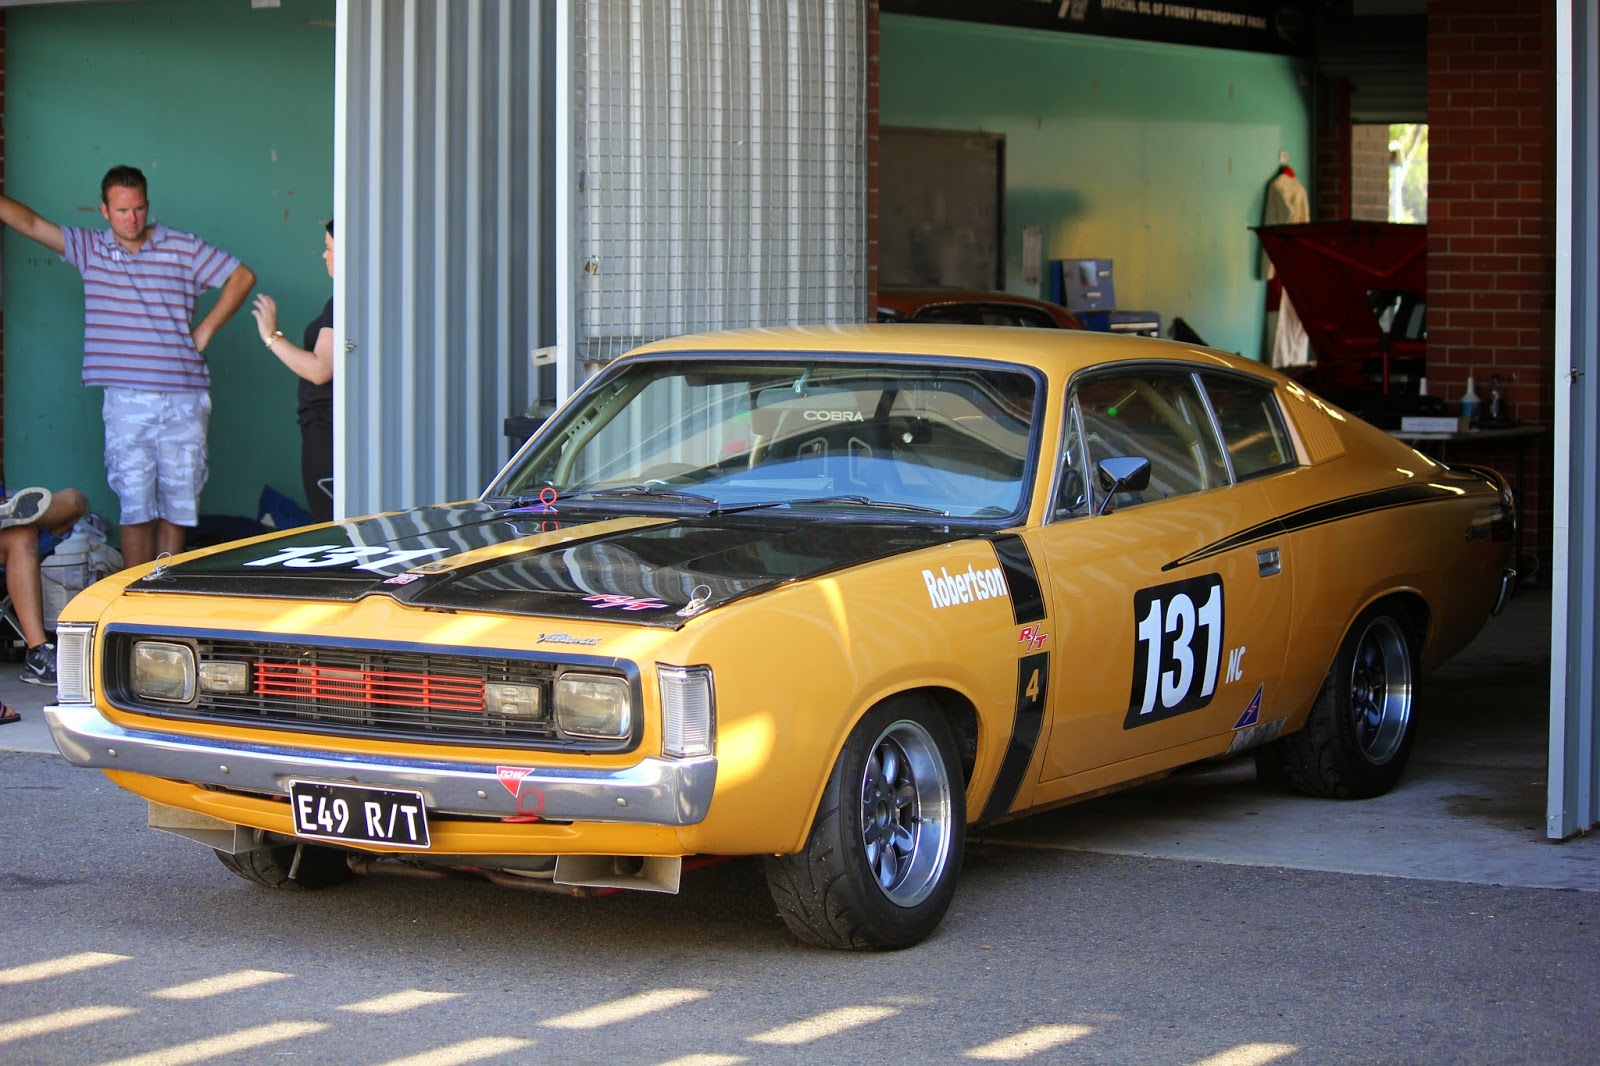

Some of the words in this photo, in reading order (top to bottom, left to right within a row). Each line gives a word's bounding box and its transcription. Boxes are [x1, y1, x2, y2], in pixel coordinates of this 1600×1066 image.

[1100, 0, 1137, 12] OFFICIAL
[1138, 1, 1151, 14] OIL
[1152, 2, 1164, 16] OF
[1164, 4, 1195, 20] SYDNEY
[1196, 8, 1246, 27] MOTORSPORT
[1247, 14, 1267, 29] PARK
[803, 410, 864, 422] COBRA
[243, 545, 450, 568] 131
[921, 562, 1008, 609] Robertson
[582, 594, 669, 611] R/T
[1018, 622, 1048, 653] R/T
[1138, 584, 1222, 715] 131
[1225, 645, 1246, 684] NC
[1025, 668, 1040, 703] 4
[499, 769, 525, 779] TOW
[297, 794, 350, 834] E49
[364, 801, 418, 841] R/T
